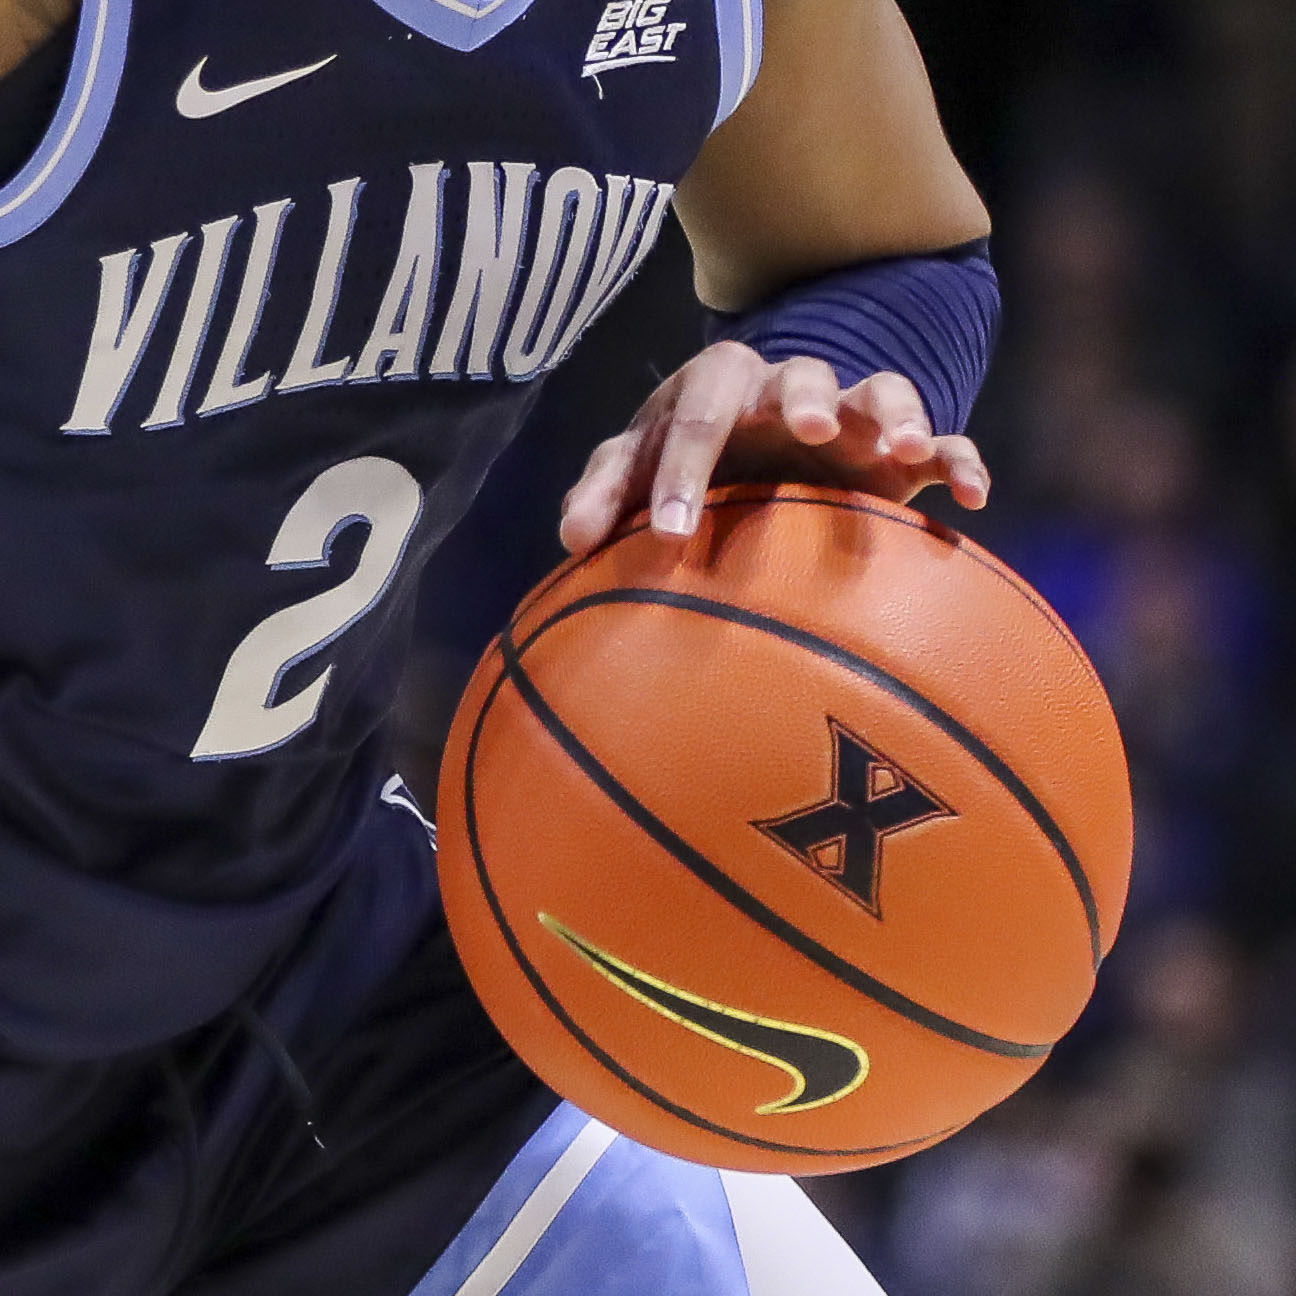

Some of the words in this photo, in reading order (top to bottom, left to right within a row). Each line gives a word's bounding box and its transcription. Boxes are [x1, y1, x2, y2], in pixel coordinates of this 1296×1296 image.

[584, 22, 687, 62] EAST
[189, 455, 424, 763] 2
[747, 714, 959, 922] X
